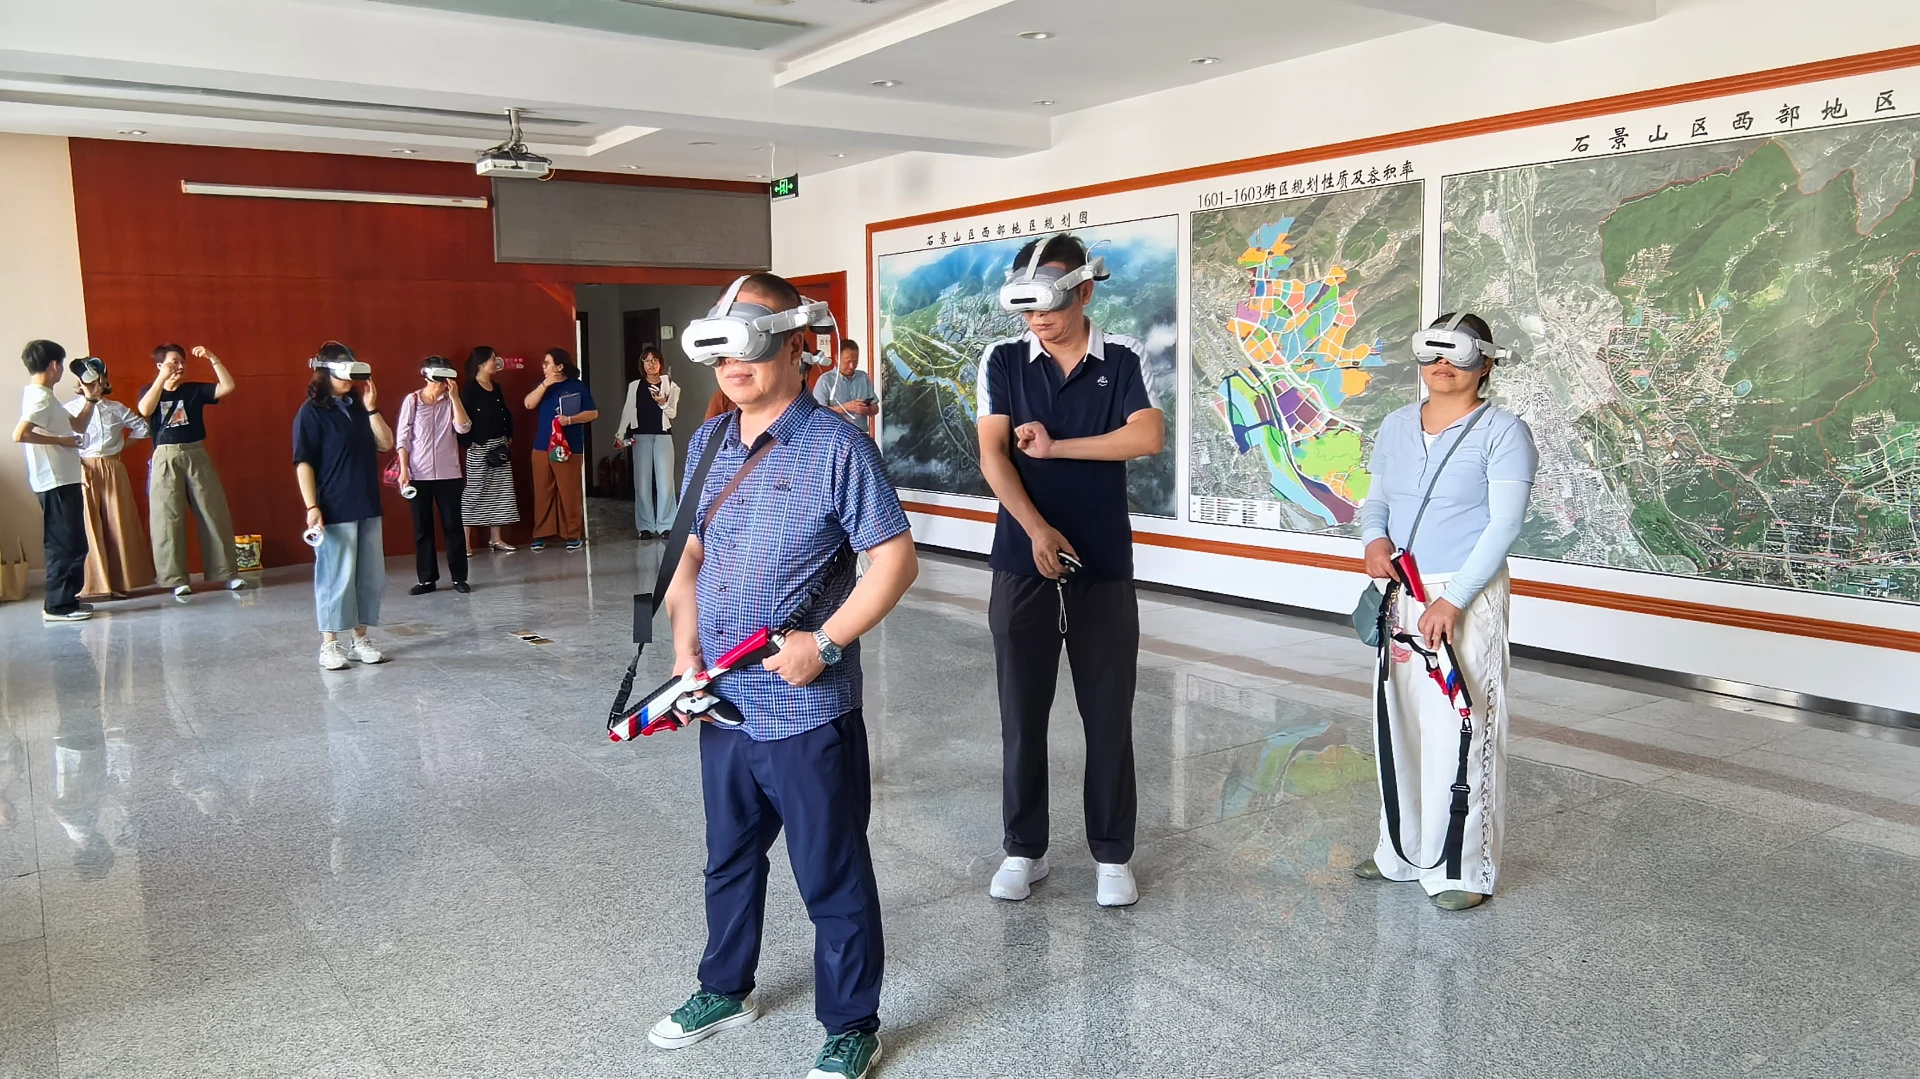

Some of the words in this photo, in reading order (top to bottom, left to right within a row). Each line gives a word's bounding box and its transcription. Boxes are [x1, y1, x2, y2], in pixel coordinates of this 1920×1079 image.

[1571, 90, 1896, 152] 石景山区西部地区
[1198, 160, 1414, 208] 1601-1603街区规划性质及容积率
[926, 211, 1088, 246] 石景山区西部地区规划图
